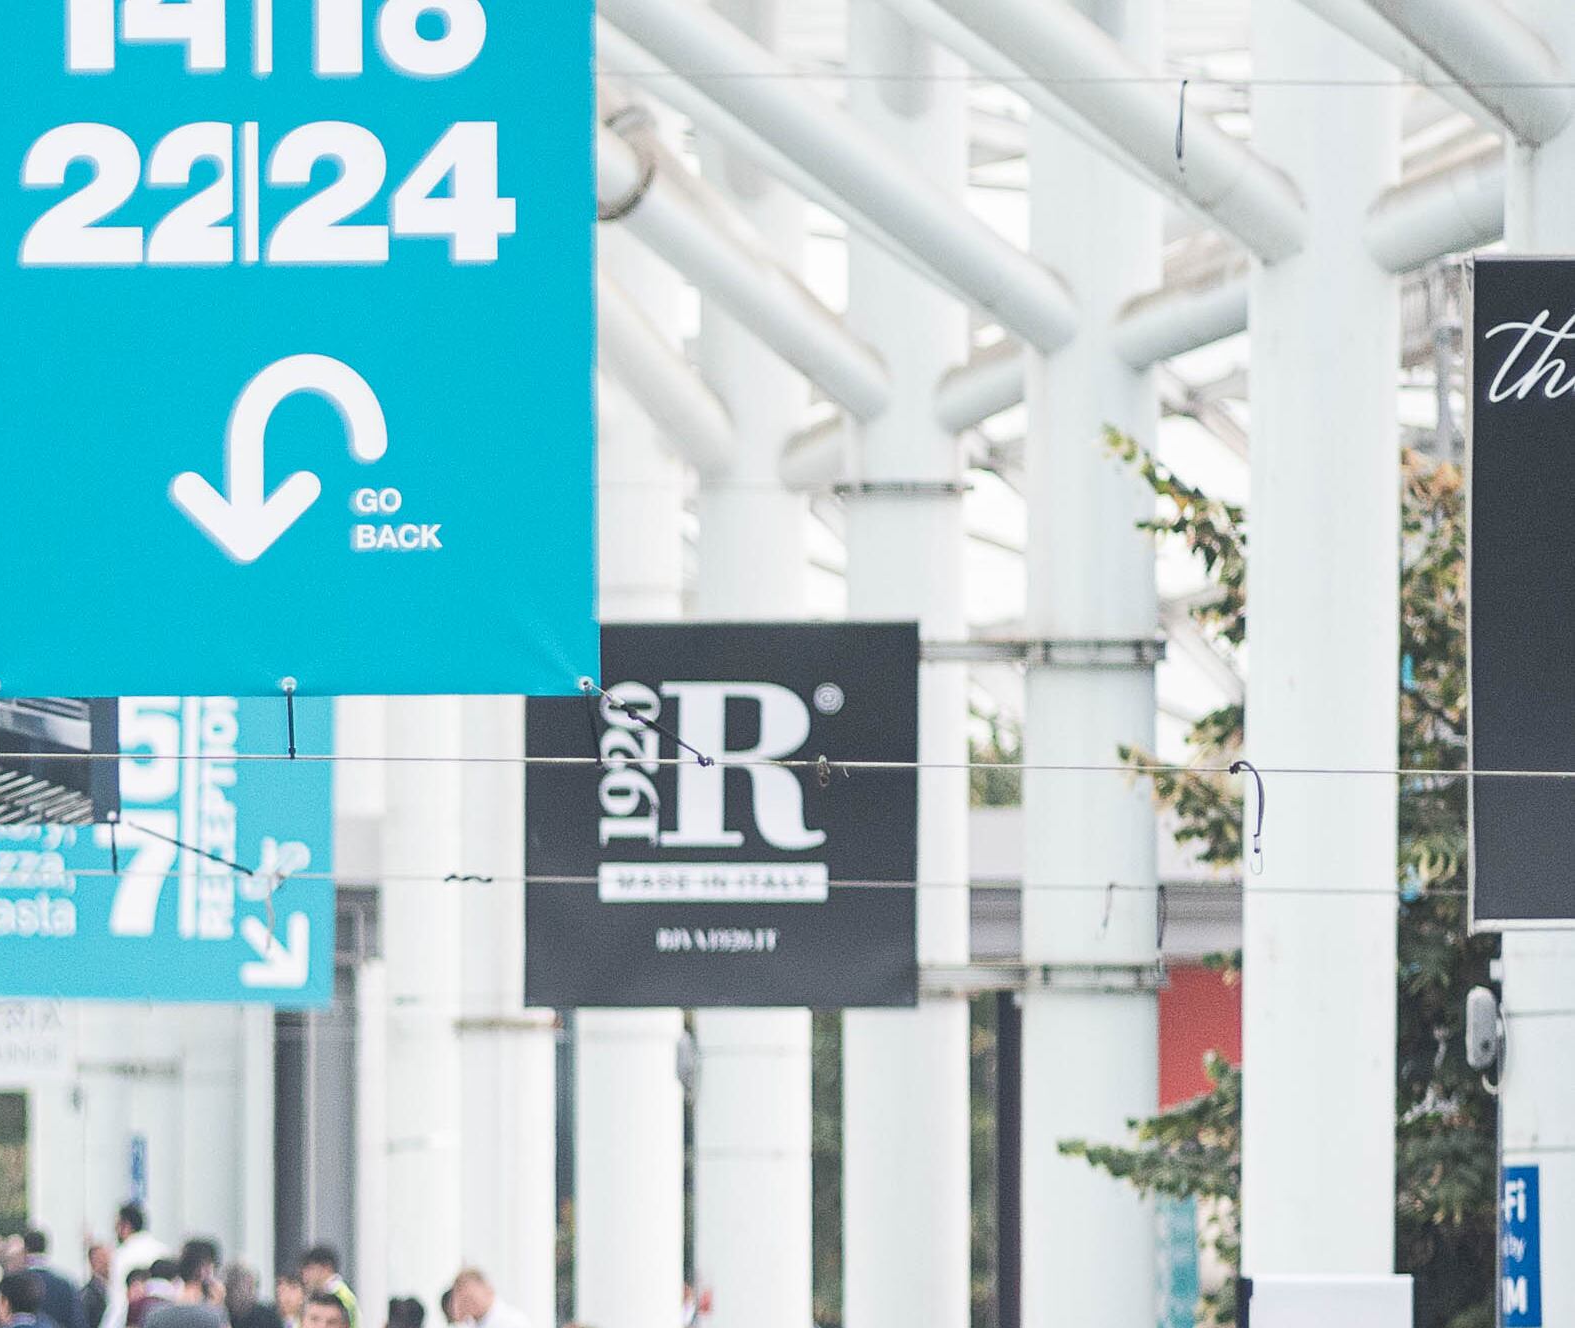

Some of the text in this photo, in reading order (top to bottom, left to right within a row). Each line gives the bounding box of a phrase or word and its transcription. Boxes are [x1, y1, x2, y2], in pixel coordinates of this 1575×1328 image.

[1485, 308, 1575, 403] th
[352, 487, 403, 514] GO
[352, 523, 444, 551] BACK
[598, 682, 662, 847] 1920
[94, 808, 179, 939] 7
